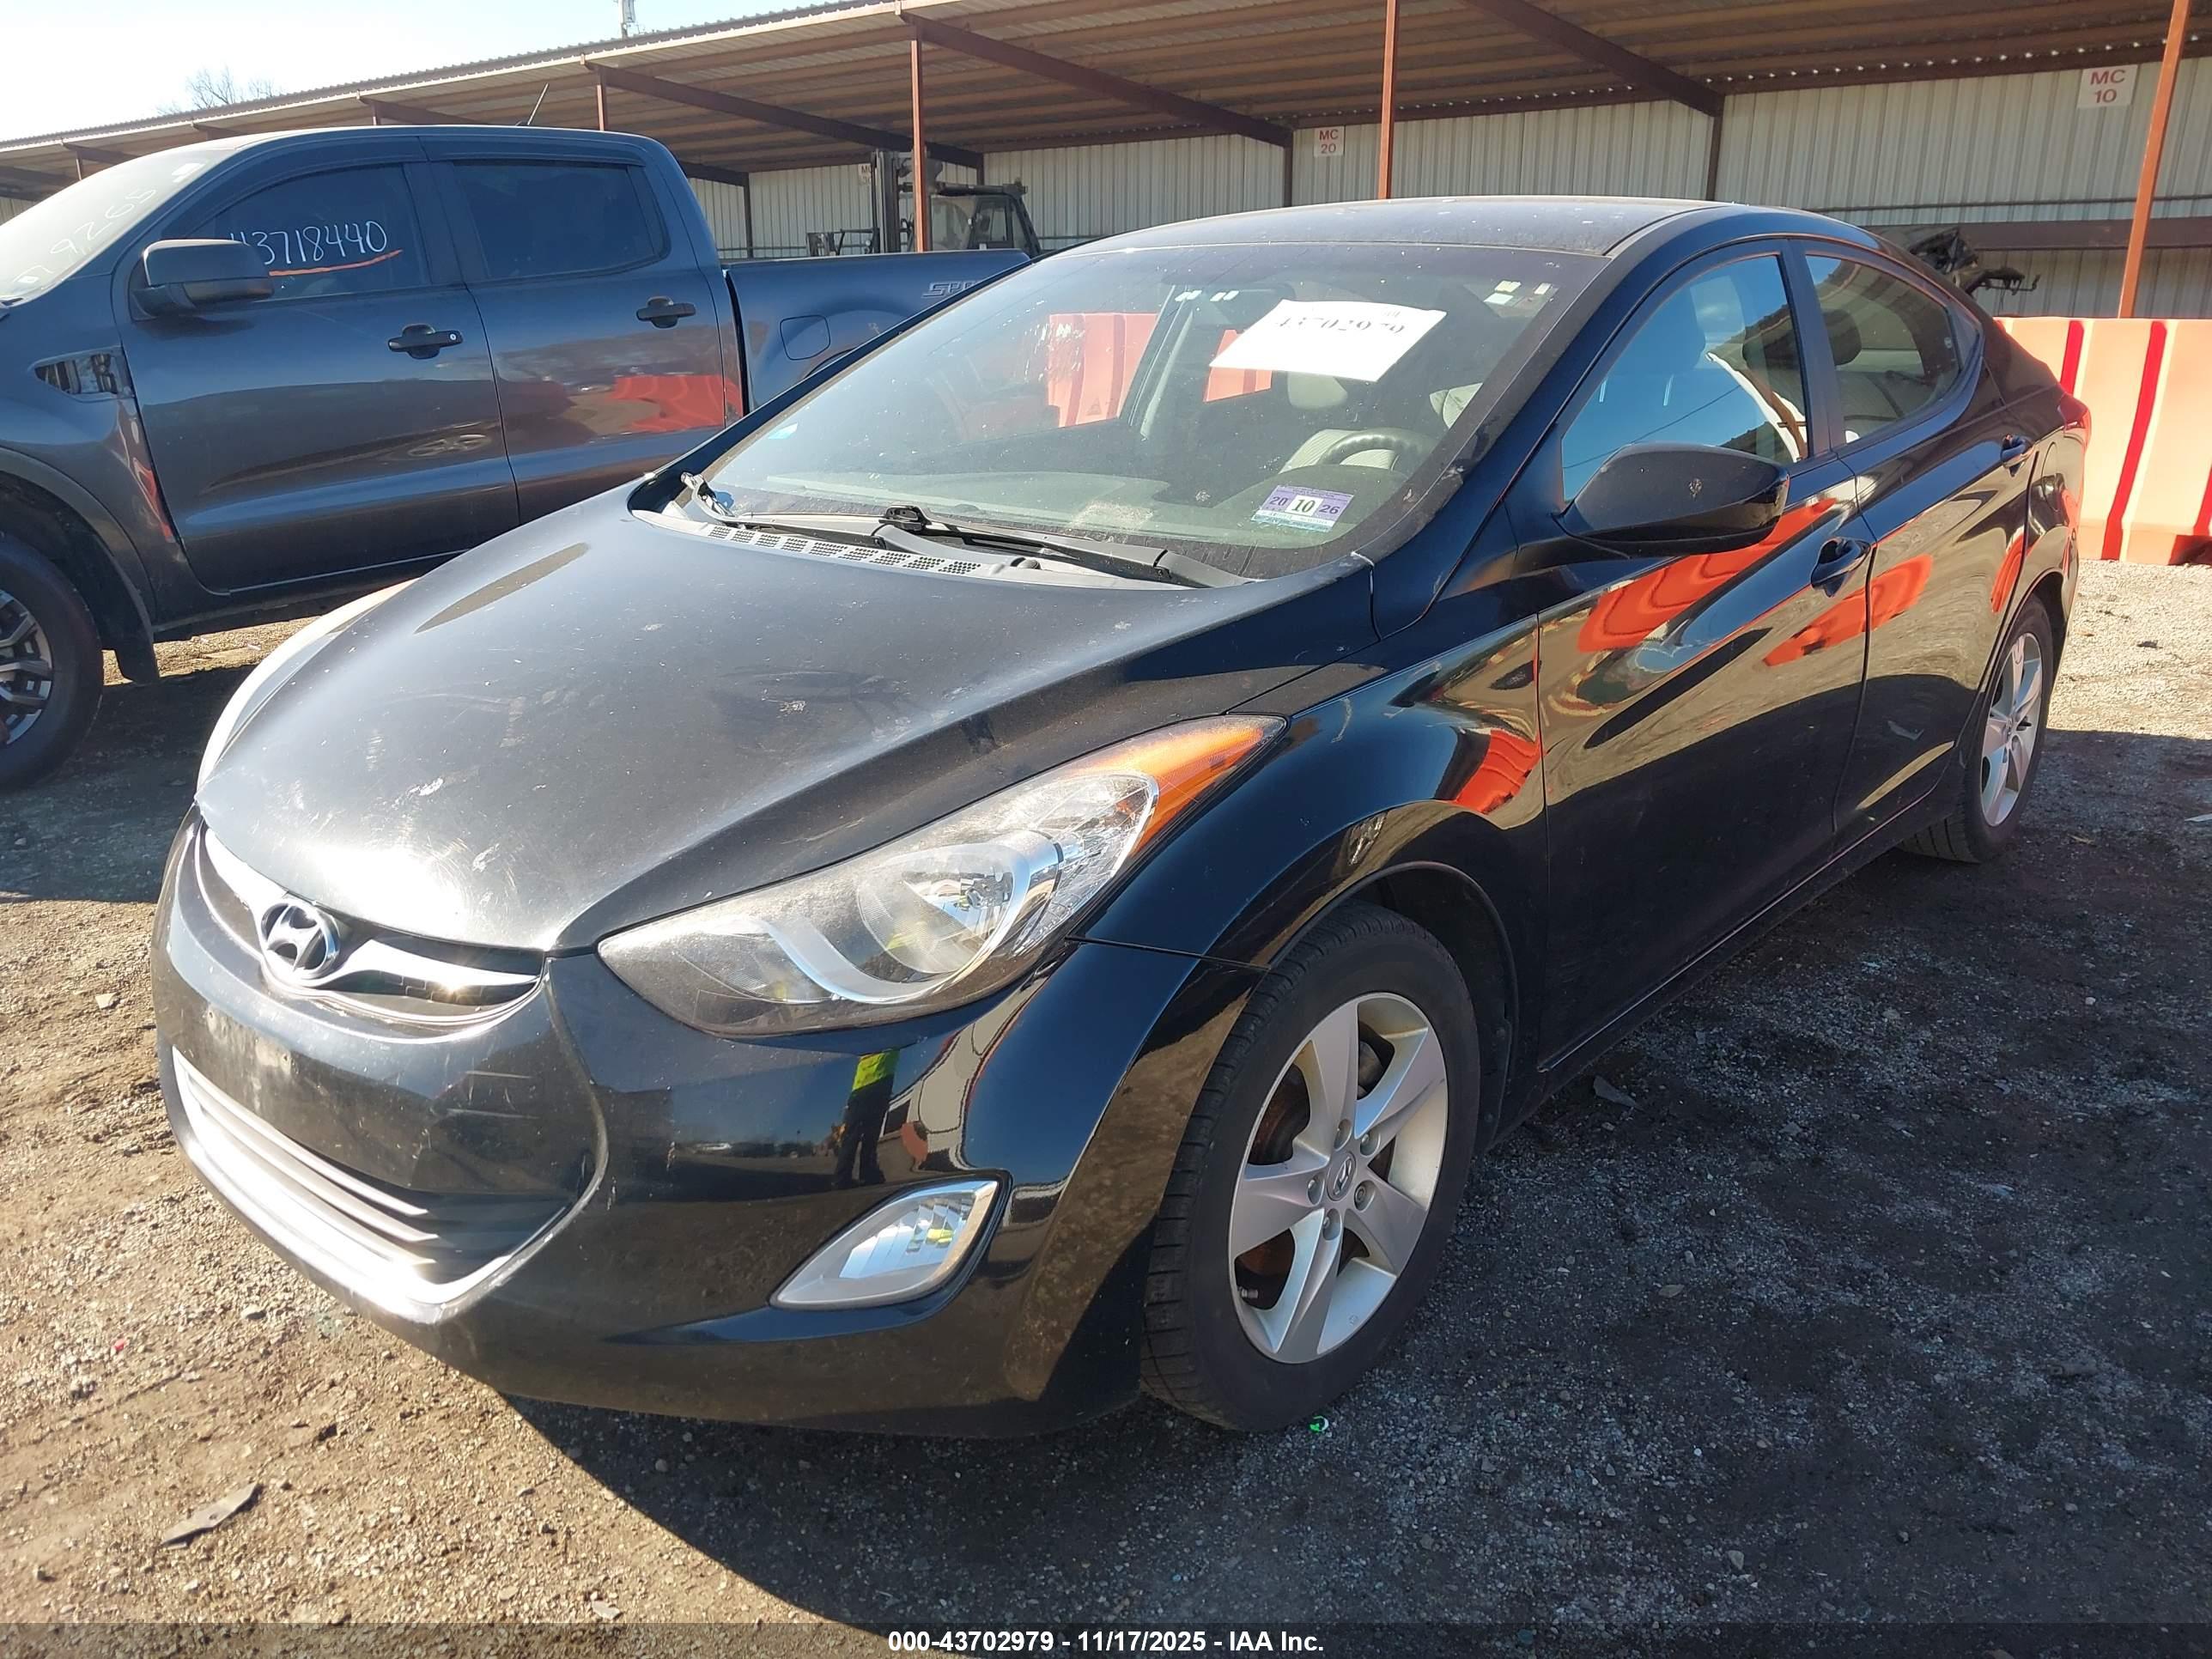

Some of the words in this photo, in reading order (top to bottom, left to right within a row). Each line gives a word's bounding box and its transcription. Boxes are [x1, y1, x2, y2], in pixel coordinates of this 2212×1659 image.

[2089, 69, 2126, 85] MC
[2094, 88, 2118, 104] 10
[1319, 129, 1339, 141] MC
[1321, 143, 1337, 155] 20
[1269, 496, 1289, 507] 20
[1291, 499, 1316, 514] 10
[1318, 504, 1340, 515] 26
